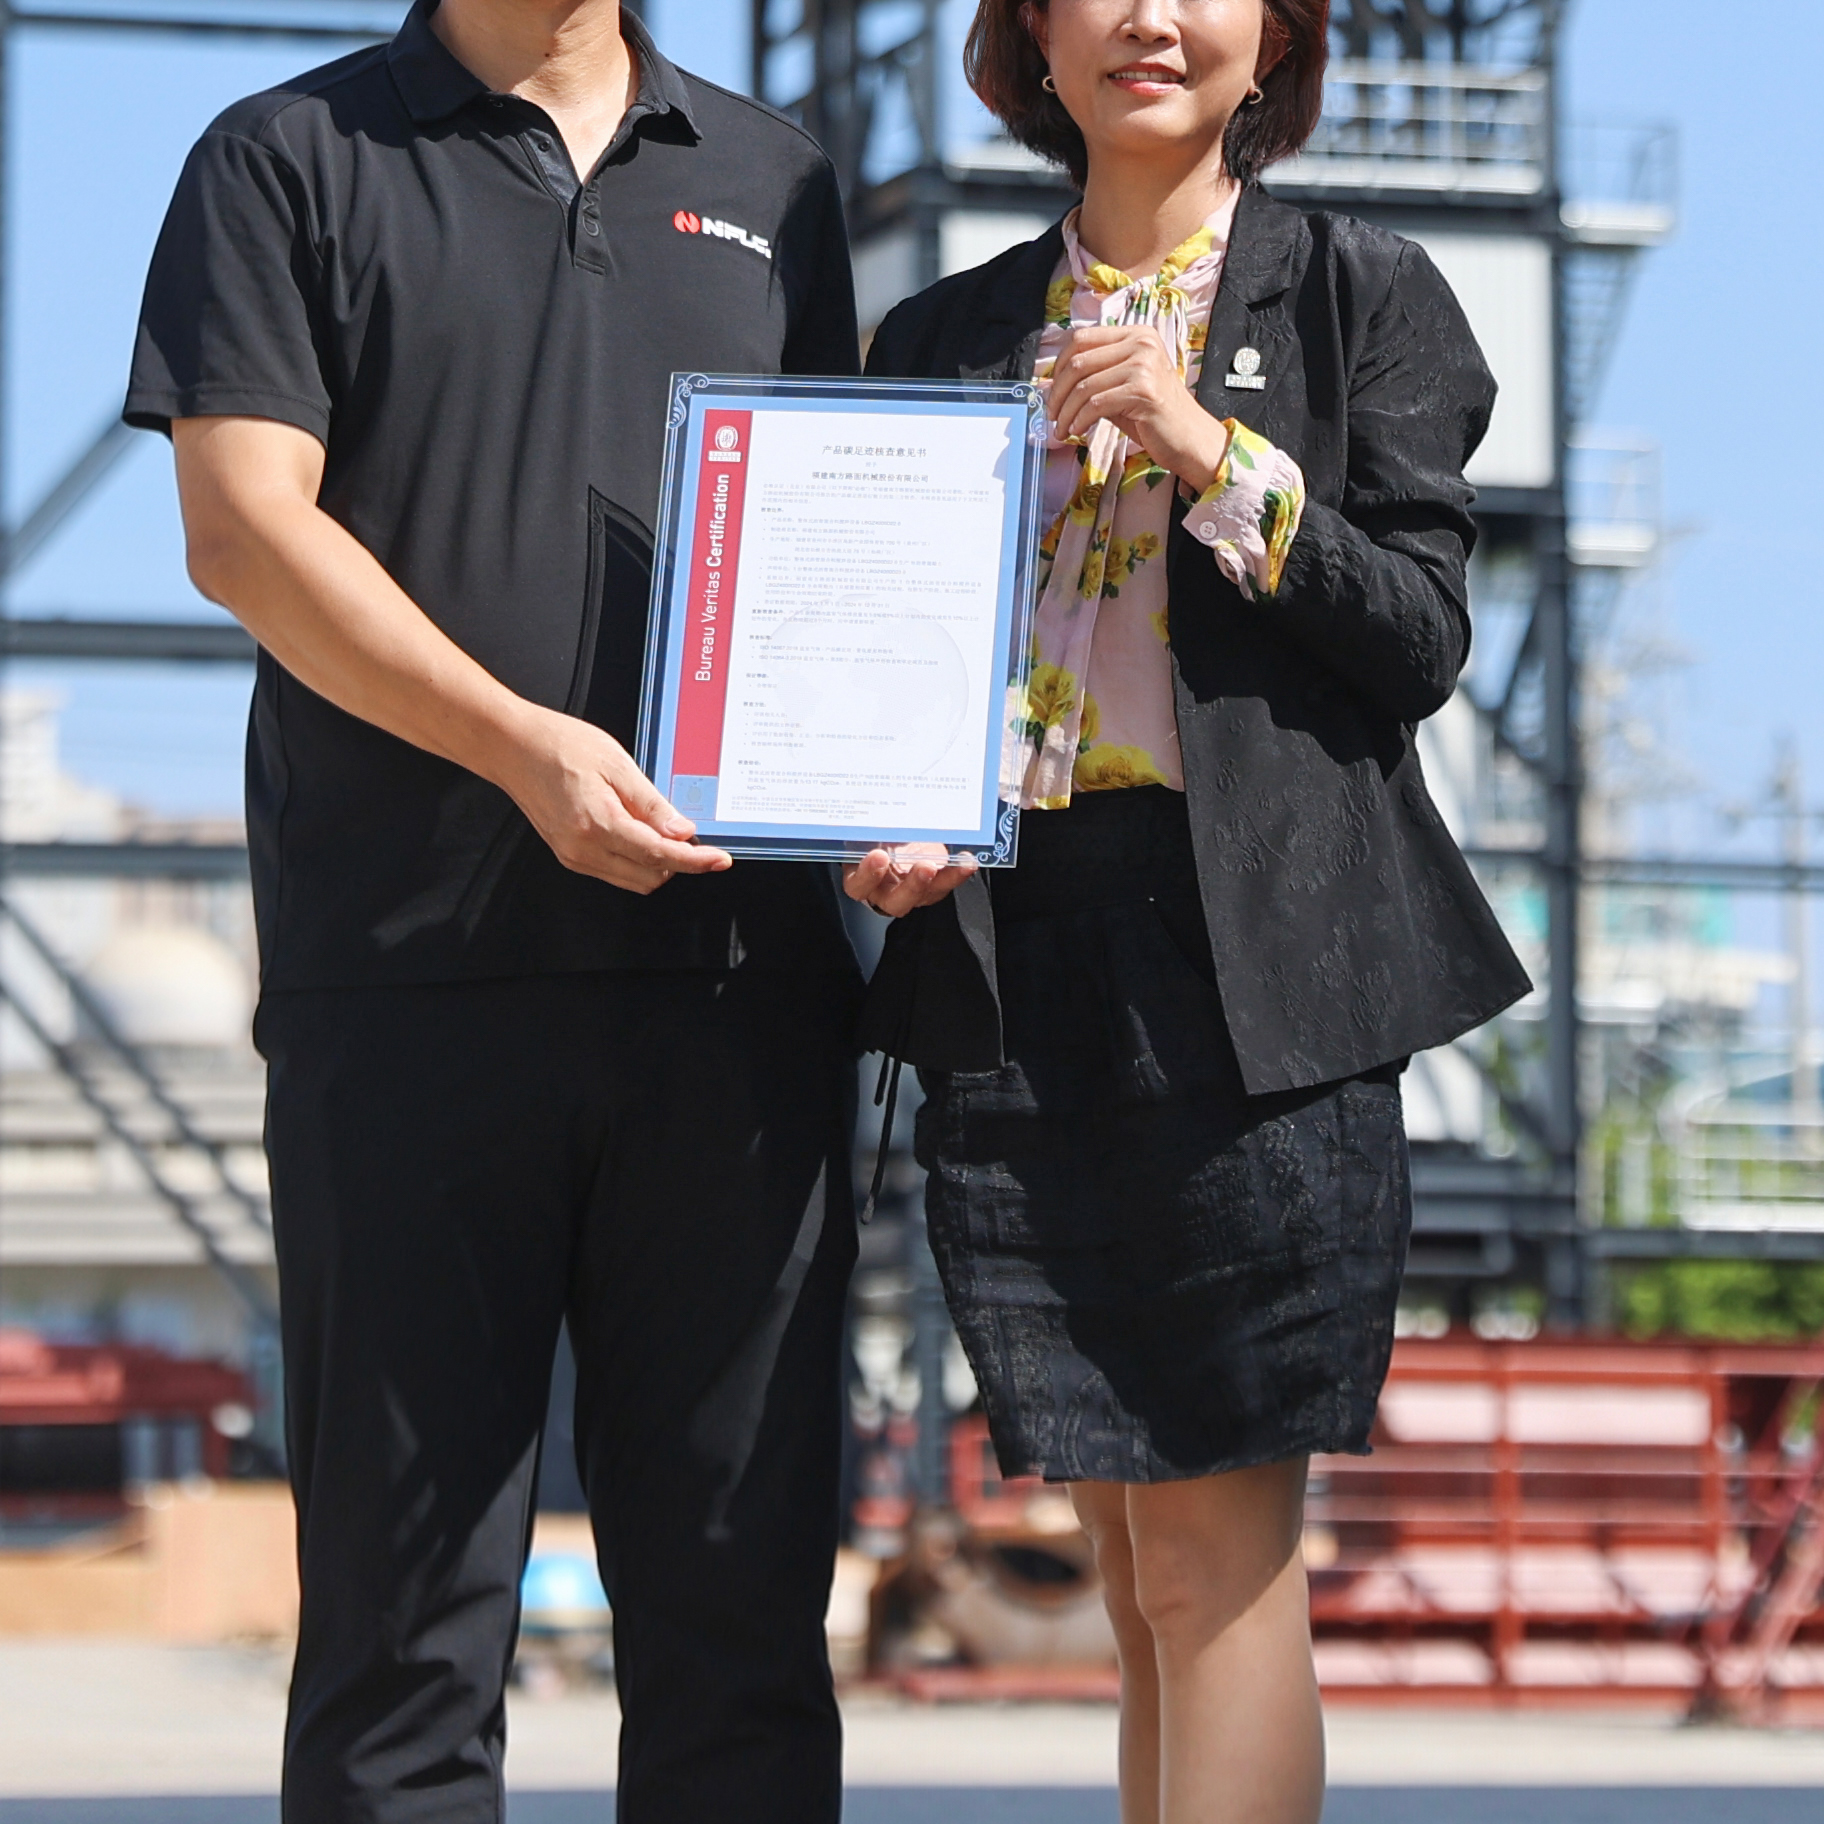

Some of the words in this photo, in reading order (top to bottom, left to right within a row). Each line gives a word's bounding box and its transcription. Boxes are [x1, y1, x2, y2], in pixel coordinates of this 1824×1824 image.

[706, 474, 730, 567] Certification
[701, 572, 720, 623] Veritas
[695, 627, 715, 681] Bureau
